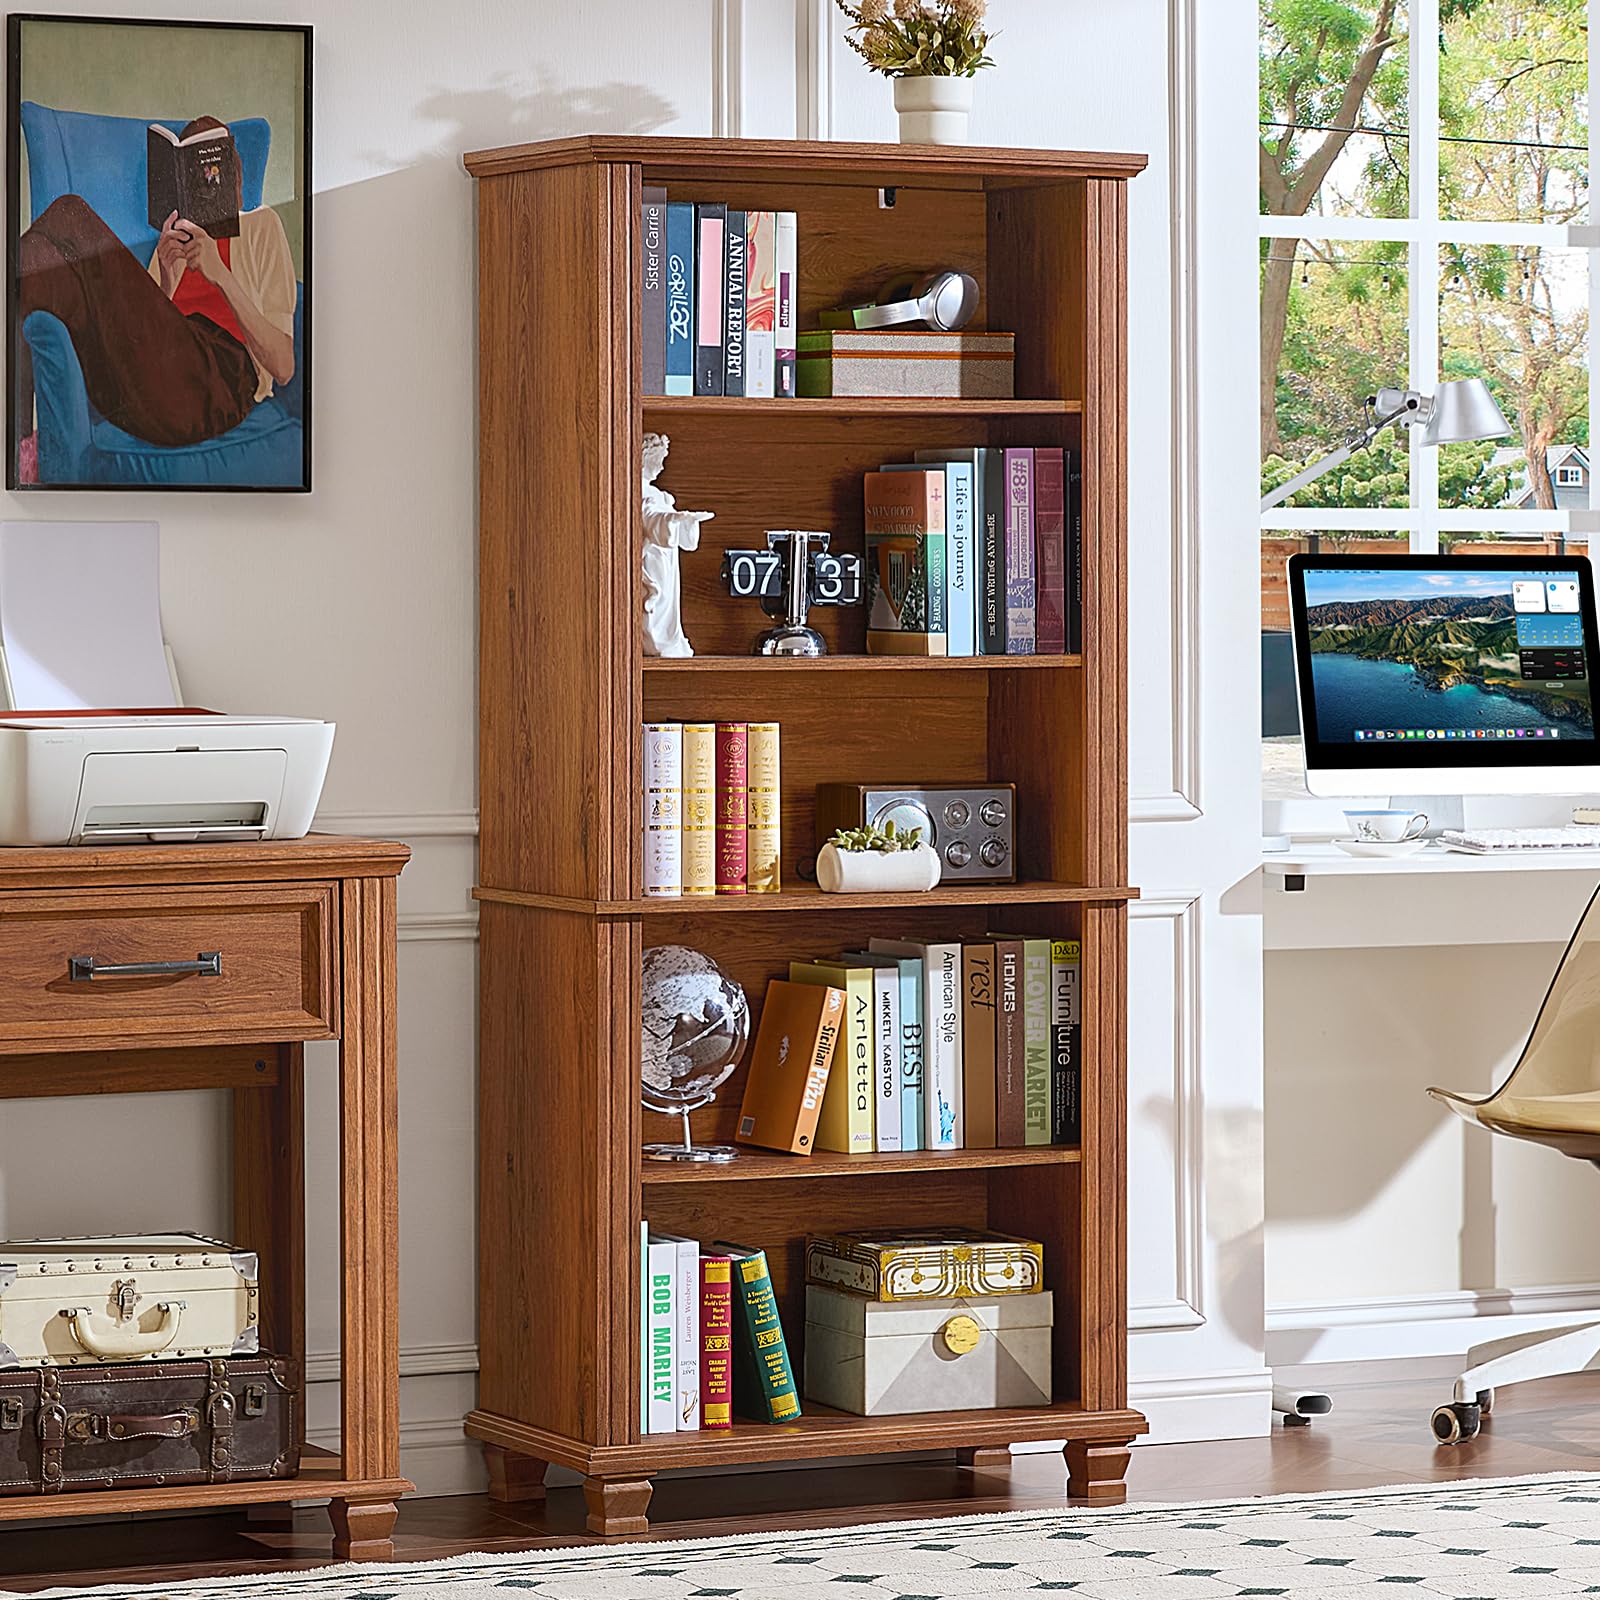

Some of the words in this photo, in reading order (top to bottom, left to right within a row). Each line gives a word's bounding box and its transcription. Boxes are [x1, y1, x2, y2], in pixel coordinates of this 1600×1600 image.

[645, 207, 659, 250] Carrie
[645, 252, 659, 290] Sister
[728, 233, 744, 304] ANNUAL
[780, 299, 789, 326] olivia
[727, 307, 743, 378] REPORT
[955, 476, 967, 506] Life
[955, 509, 967, 520] is
[733, 556, 779, 594] 07
[820, 558, 860, 598] 31
[953, 534, 967, 592] journey
[988, 597, 996, 624] BEST
[1054, 945, 1079, 954] D&D
[943, 952, 956, 1009] American
[970, 958, 996, 1011] rest
[1004, 954, 1016, 1012] HOMES
[1026, 956, 1046, 1042] FLOWER
[940, 1012, 957, 1043] Style
[1058, 969, 1075, 1065] Furniture
[815, 1026, 836, 1066] Sicilian
[856, 996, 868, 1110] Arletta
[883, 1044, 892, 1098] KARSTOD
[902, 1023, 922, 1095] BEST
[1026, 1048, 1046, 1131] MARKET
[652, 1274, 671, 1316] BOB
[652, 1328, 671, 1403] MARLEY
